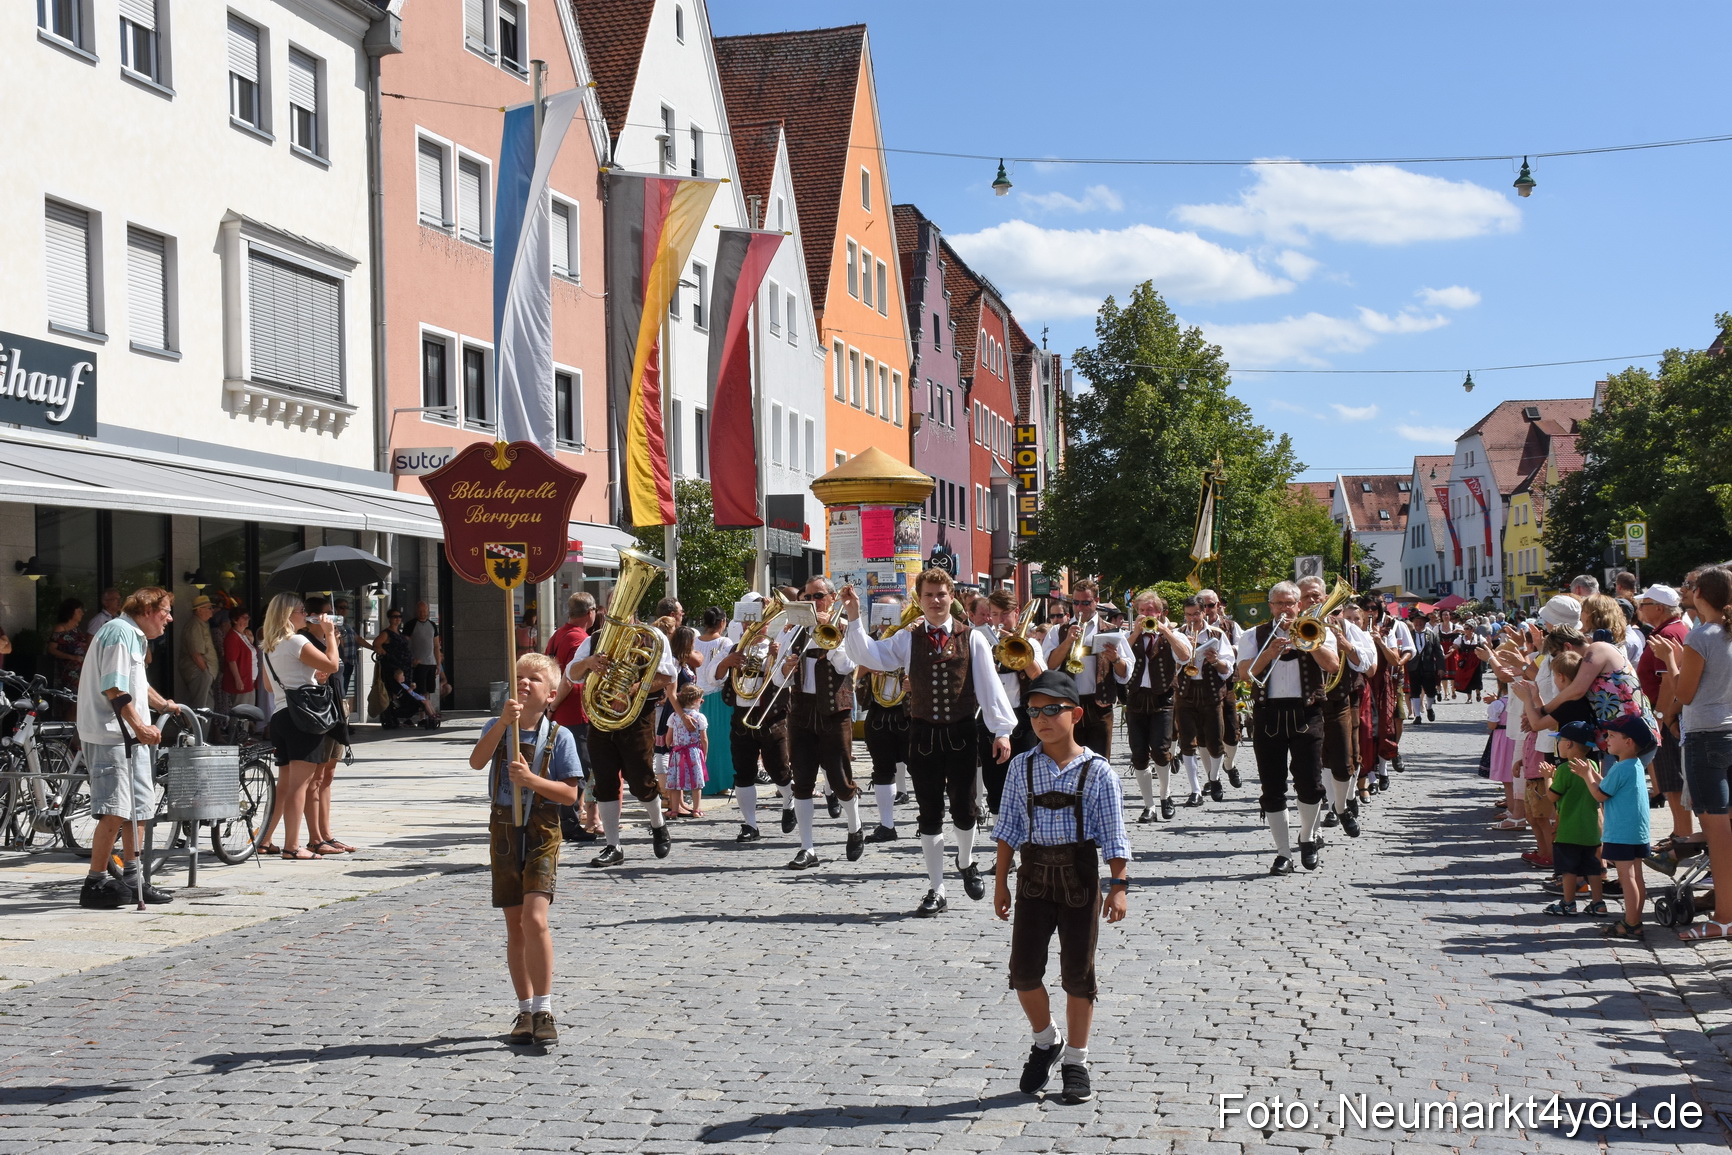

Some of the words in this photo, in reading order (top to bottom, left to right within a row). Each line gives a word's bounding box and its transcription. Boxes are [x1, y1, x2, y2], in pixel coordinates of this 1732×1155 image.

[396, 453, 450, 470] sutor
[448, 480, 558, 504] Blaskapelle
[1017, 427, 1037, 535] HOTEL
[464, 504, 543, 530] Berngau
[470, 547, 480, 556] 19
[532, 546, 543, 556] 73
